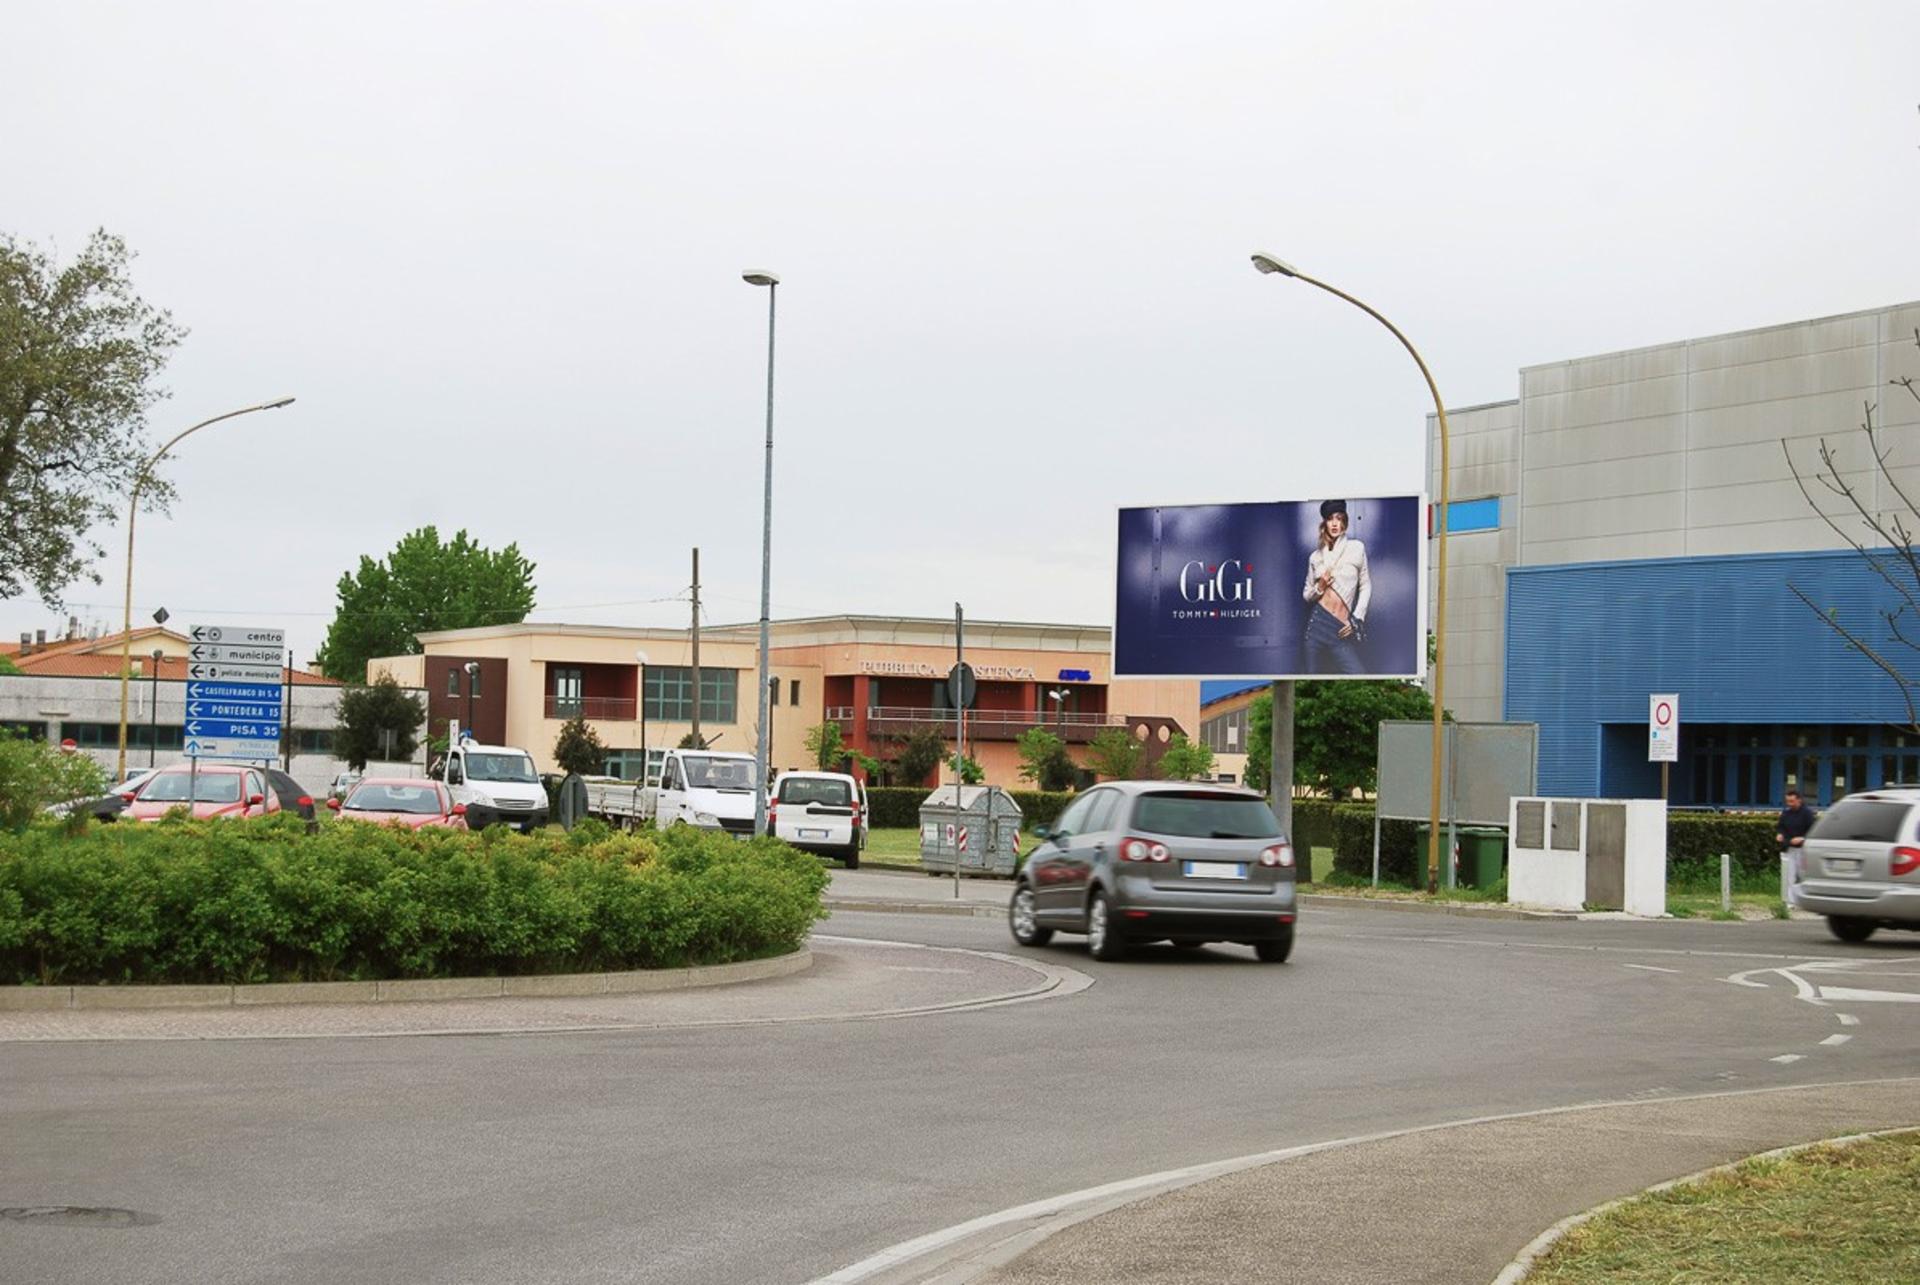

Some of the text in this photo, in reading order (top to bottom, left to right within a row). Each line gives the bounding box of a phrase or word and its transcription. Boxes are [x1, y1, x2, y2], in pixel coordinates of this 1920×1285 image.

[1180, 559, 1254, 603] GiGi
[1172, 609, 1261, 619] TOMMY HILFIGER
[247, 633, 282, 642] centro
[229, 650, 281, 662] municipio
[860, 661, 937, 676] PUBBLICA
[211, 705, 279, 717] PONTEDERA 15
[230, 725, 279, 736] PISA 35
